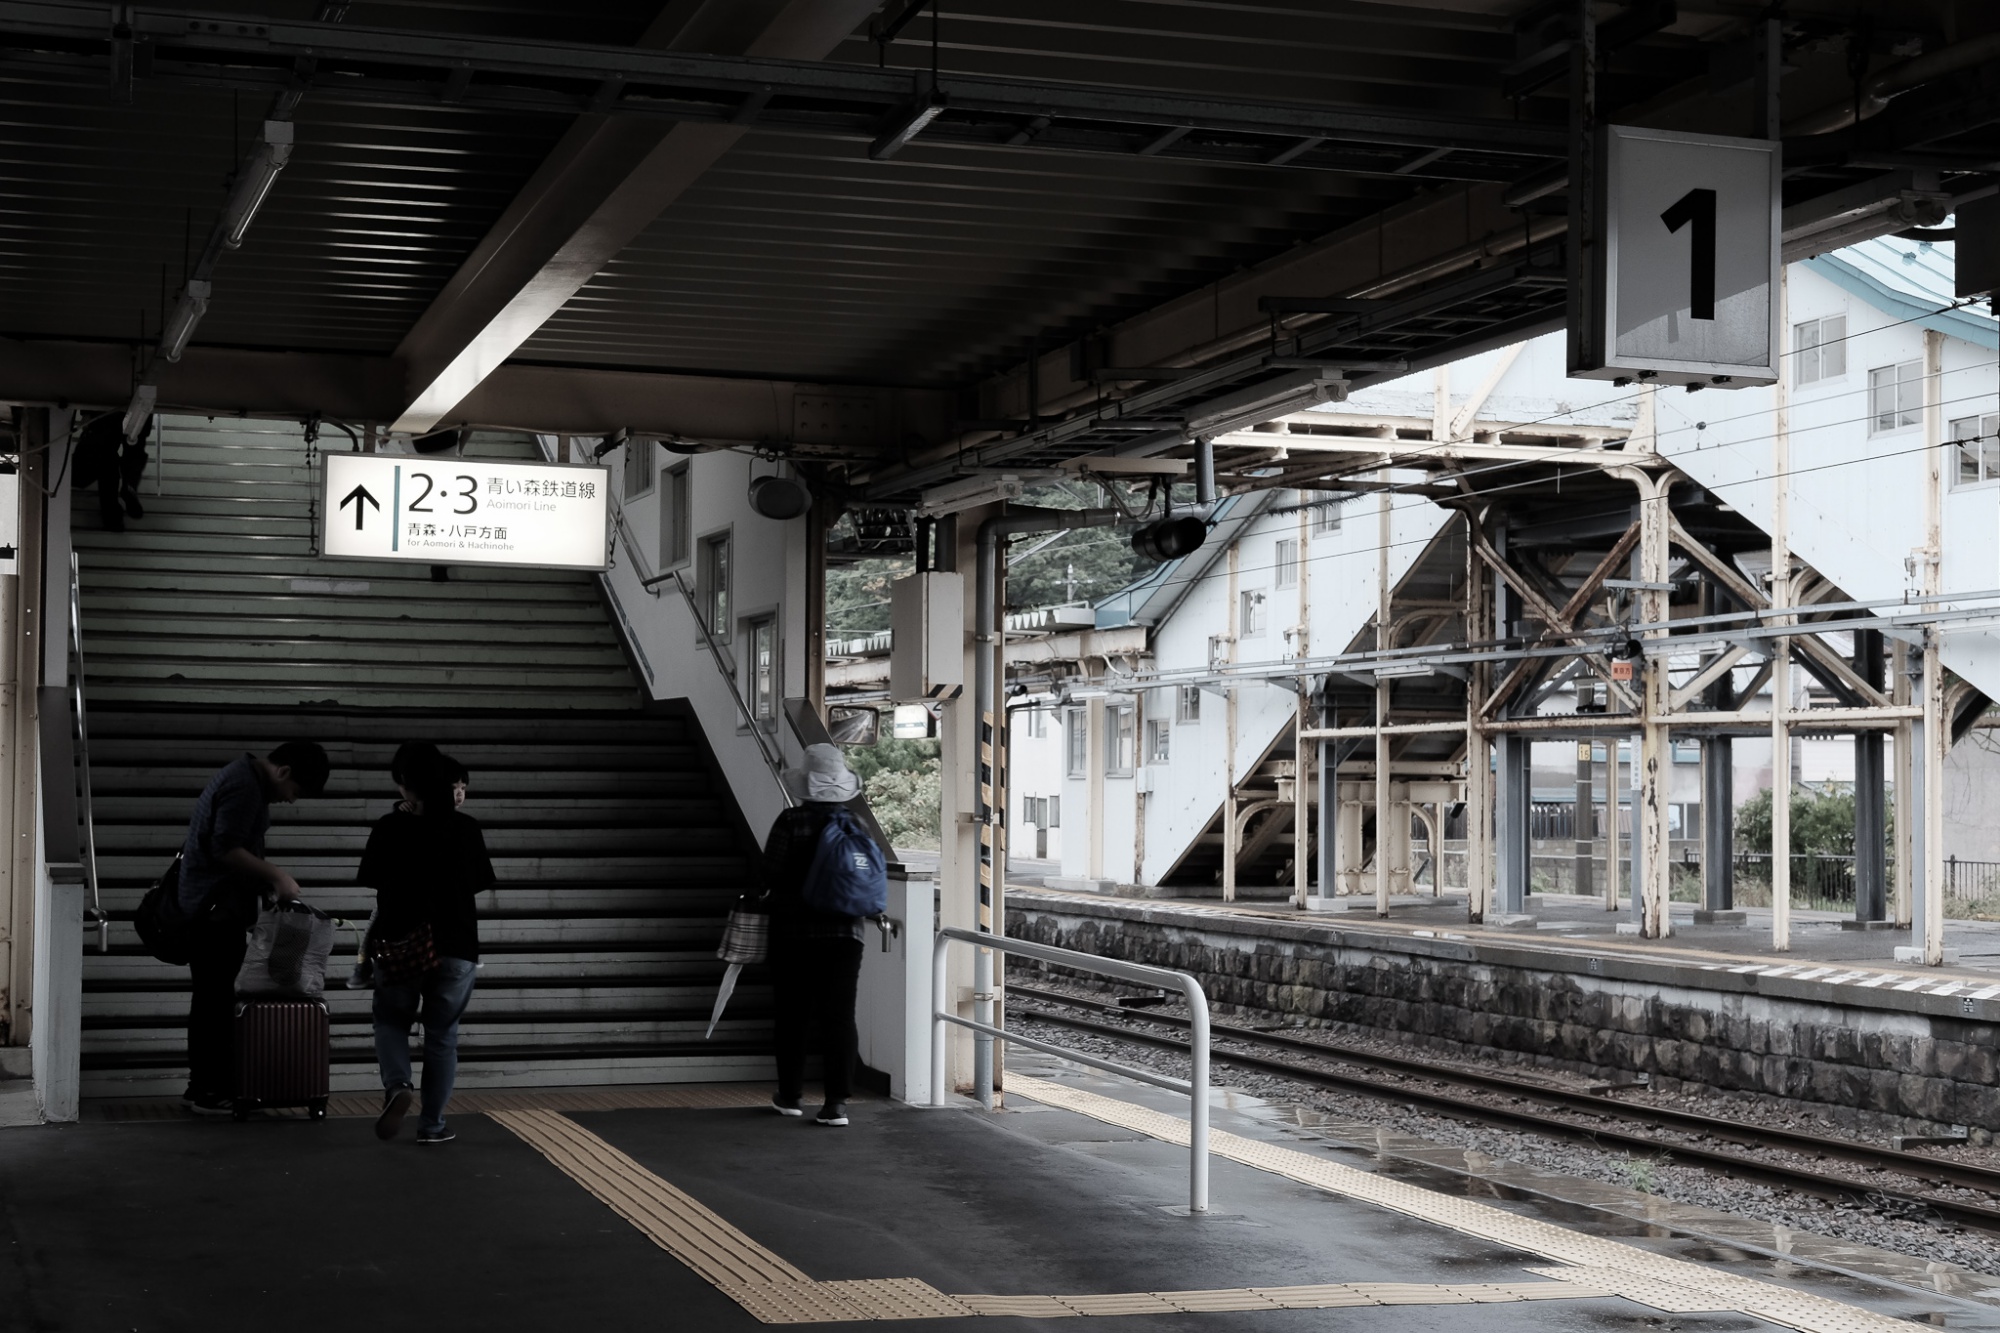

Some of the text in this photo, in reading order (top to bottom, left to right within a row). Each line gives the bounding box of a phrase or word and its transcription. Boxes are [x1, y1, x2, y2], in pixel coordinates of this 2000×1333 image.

[1660, 188, 1717, 320] 1
[487, 477, 595, 499] 青い森鉄道線
[487, 498, 557, 512] Aoimori Line
[408, 522, 507, 540] 青森・八戸方面
[407, 538, 421, 547] for
[423, 539, 456, 549] Aomori
[468, 541, 514, 551] Hachinohe
